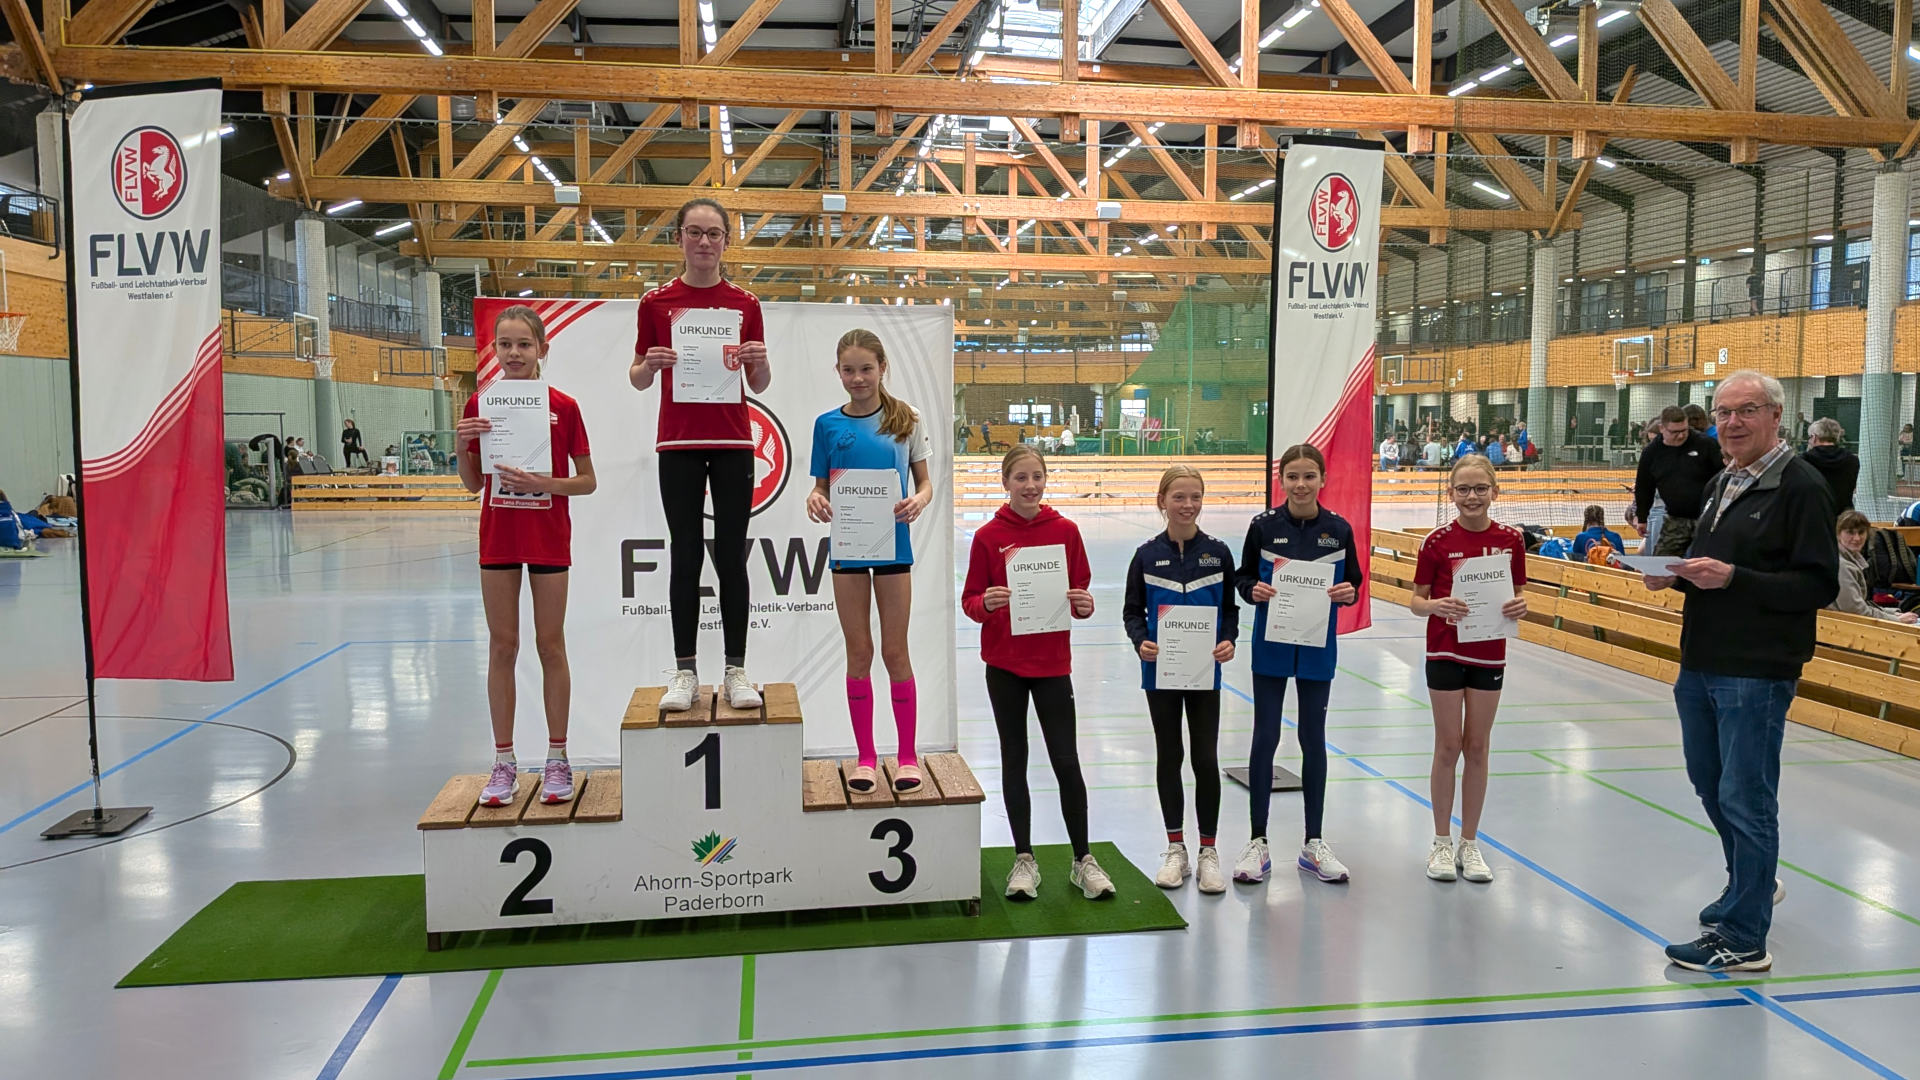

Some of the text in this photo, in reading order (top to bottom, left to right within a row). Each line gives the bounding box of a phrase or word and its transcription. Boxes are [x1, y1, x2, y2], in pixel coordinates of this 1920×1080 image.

[124, 147, 138, 202] FLVW
[1317, 189, 1328, 236] FLVW
[89, 229, 211, 277] FLVW
[119, 281, 133, 289] und
[1288, 261, 1370, 299] FLVW
[127, 292, 164, 300] Westfalen
[680, 326, 732, 335] URKUNDE
[1719, 349, 1727, 363] 3
[487, 397, 541, 405] URKUNDE
[837, 487, 888, 495] URKUNDE
[1013, 561, 1061, 572] URKUNDE
[1279, 574, 1327, 586] URKUNDE
[1461, 570, 1505, 582] URKUNDE
[622, 605, 672, 615] Fußball-
[750, 619, 771, 629] e.V.
[1164, 621, 1210, 630] URKUNDE
[685, 733, 721, 810] 1
[868, 818, 917, 894] 3
[499, 837, 554, 917] 2
[634, 867, 793, 892] Ahorn-Sportpark
[664, 894, 764, 913] Paderborn
